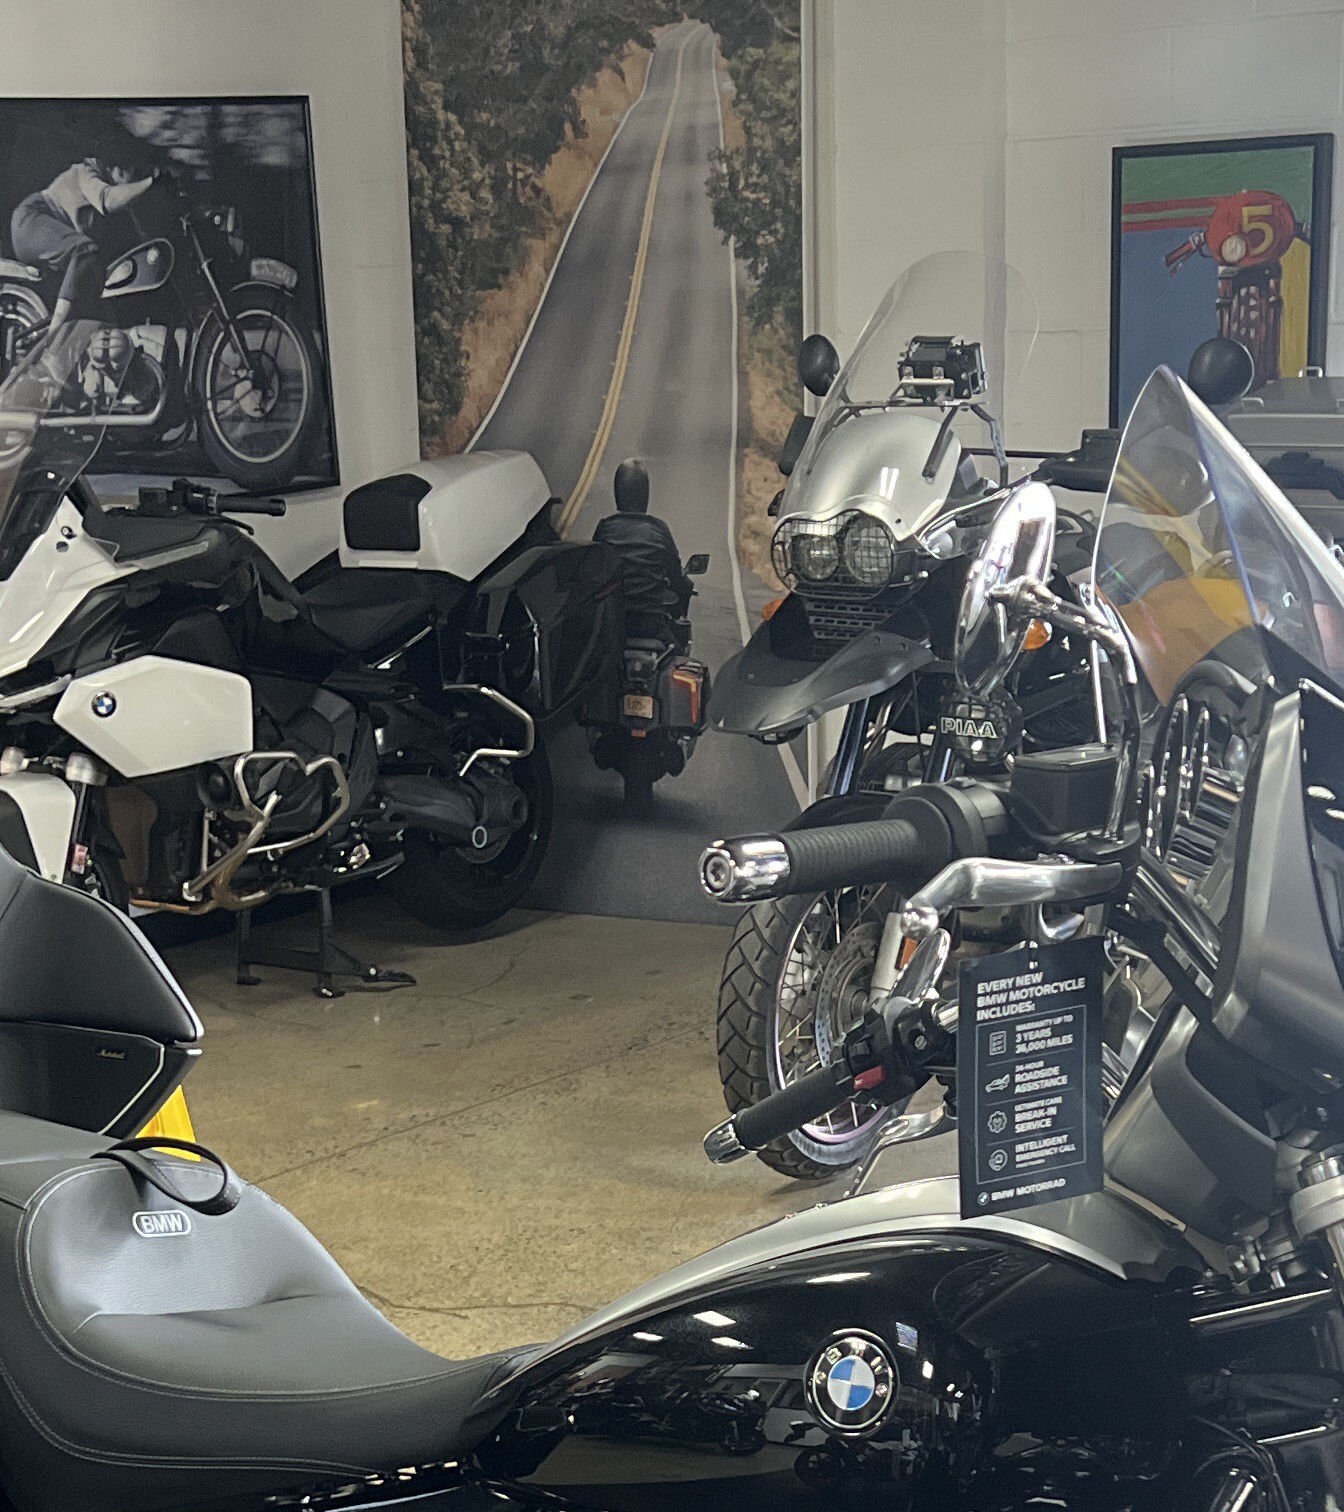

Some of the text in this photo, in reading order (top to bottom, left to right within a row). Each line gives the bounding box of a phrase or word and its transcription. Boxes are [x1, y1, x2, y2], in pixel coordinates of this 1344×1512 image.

[1241, 204, 1274, 255] 5
[940, 716, 998, 739] PIAA
[977, 972, 1043, 995] EVERY NEW
[977, 977, 1086, 1008] BMW MOTORCYCLE
[976, 1001, 1036, 1021] INCLUDES:
[1053, 1016, 1063, 1025] UP
[1063, 1014, 1074, 1023] TO
[1015, 1027, 1052, 1043] 3 YEARS
[1047, 1034, 1074, 1047] MILES
[1015, 1066, 1060, 1083] ROADSIDE
[1014, 1075, 1068, 1094] ASSISTANCE
[1014, 1105, 1057, 1122] BREAK-IN
[1014, 1117, 1052, 1133] SERVICE
[1015, 1134, 1068, 1153] INTELLIGENT
[1015, 1143, 1076, 1162] EMERGENCY CALL
[991, 1178, 1066, 1201] BMW MOTORRAD
[139, 1213, 183, 1233] BMW
